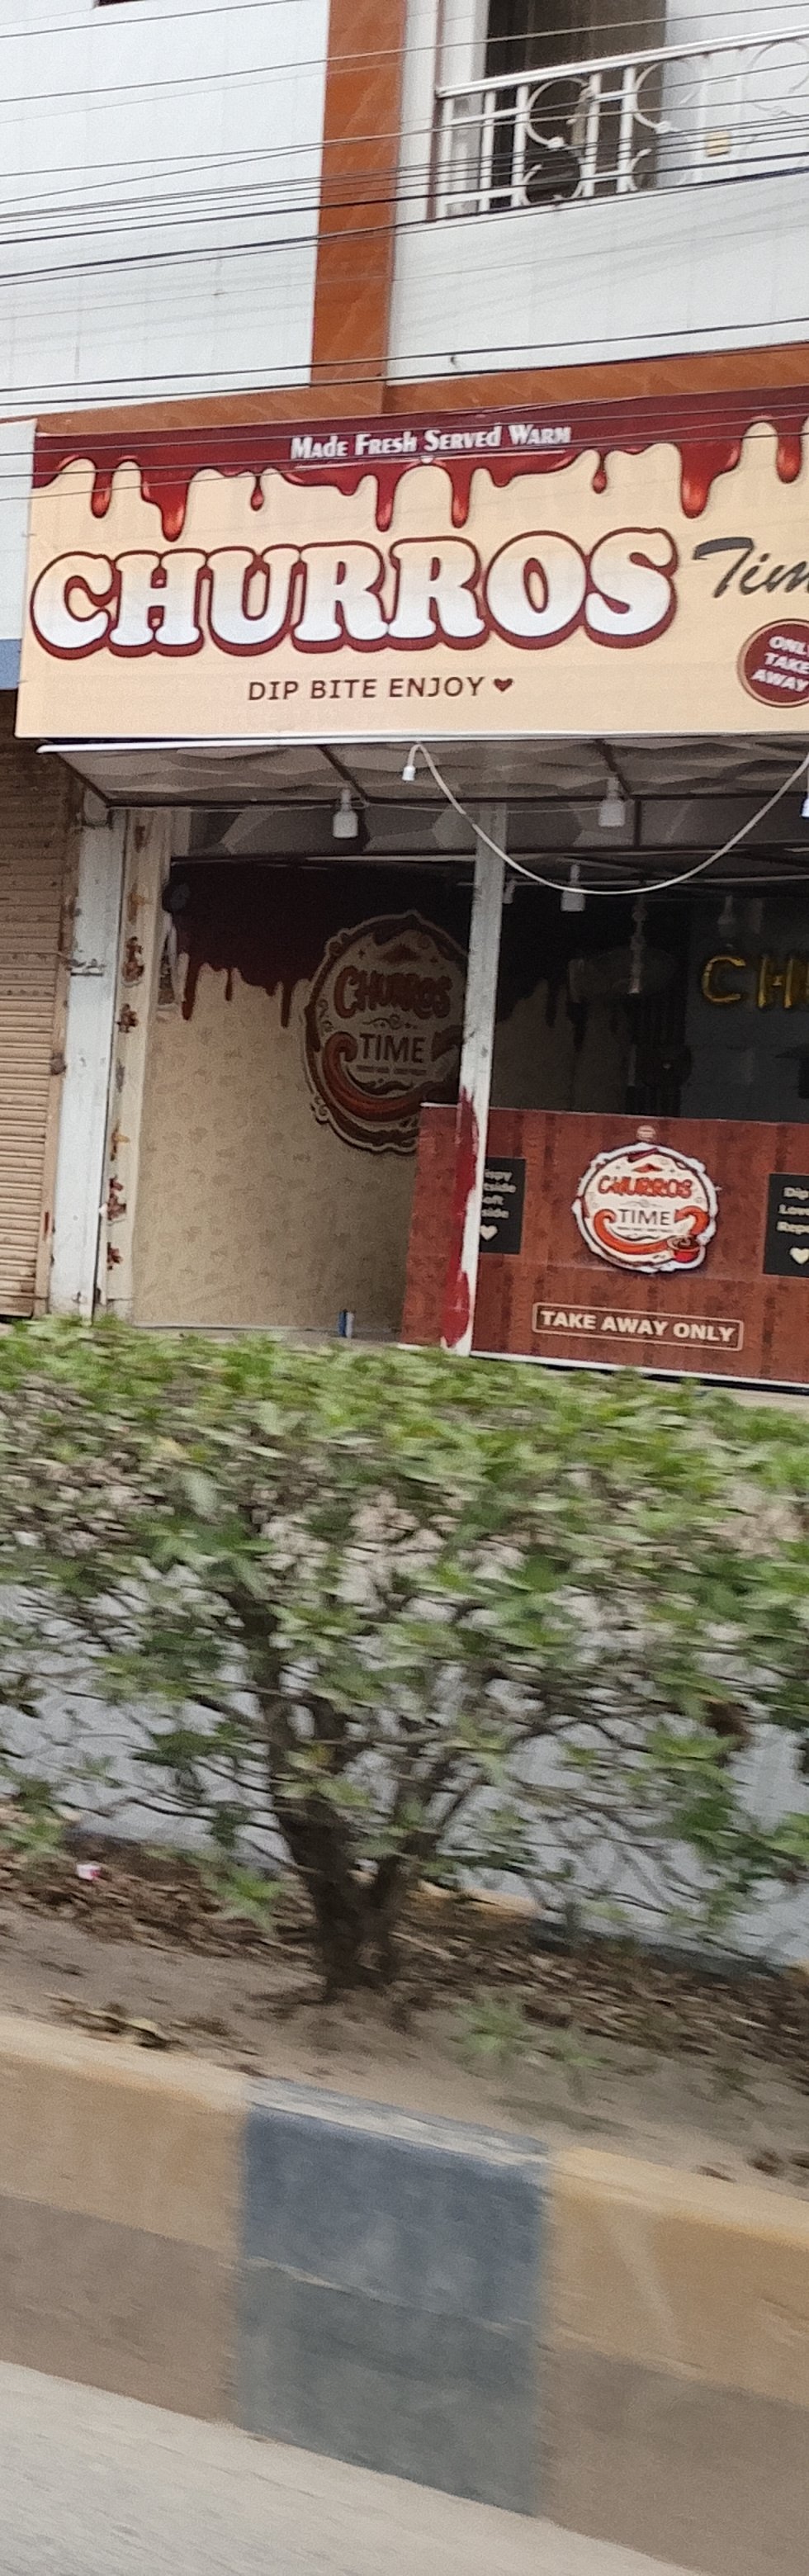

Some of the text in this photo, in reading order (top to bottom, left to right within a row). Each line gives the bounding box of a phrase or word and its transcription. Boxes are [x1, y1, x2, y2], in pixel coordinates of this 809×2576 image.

[291, 424, 571, 459] Made Fresh Served Warm
[31, 527, 809, 660] CHURROS Tim
[769, 636, 809, 657] ONL
[764, 651, 809, 675] TAKE
[248, 676, 485, 700] DIP BITE ENJOY
[750, 669, 809, 692] AWAY
[703, 956, 809, 1009] CH
[359, 1033, 426, 1063] TIME
[598, 1175, 693, 1199] CHURROS
[617, 1209, 670, 1226] TIME
[541, 1310, 736, 1342] TAKE AWAY ONLY
